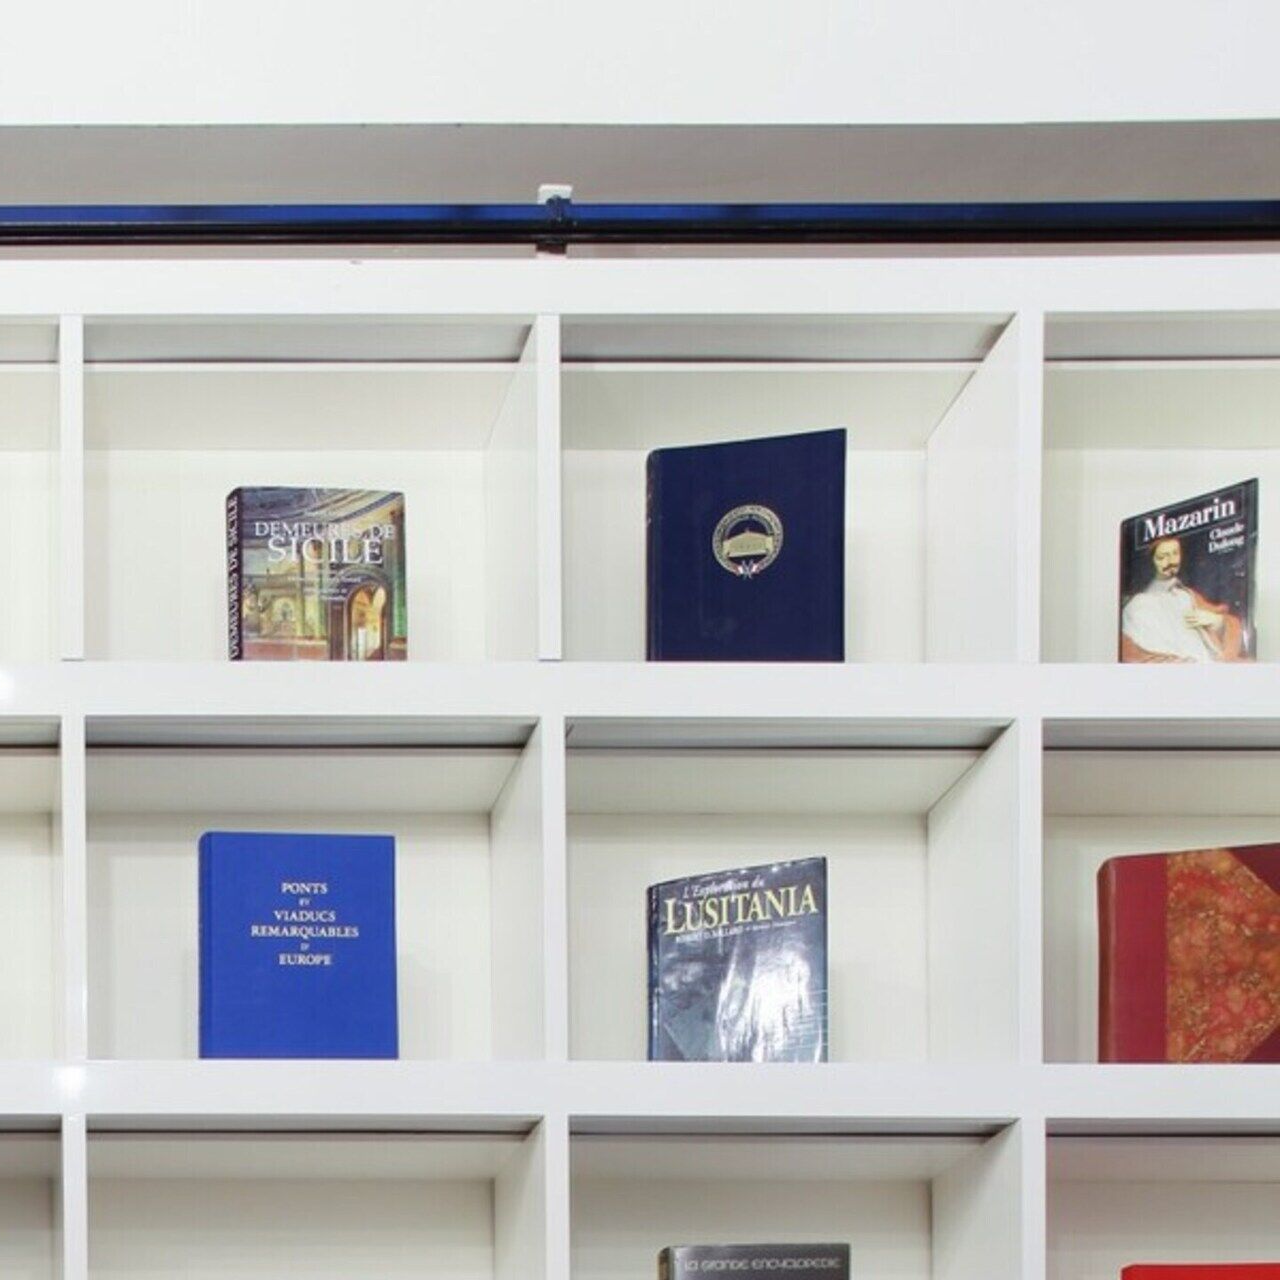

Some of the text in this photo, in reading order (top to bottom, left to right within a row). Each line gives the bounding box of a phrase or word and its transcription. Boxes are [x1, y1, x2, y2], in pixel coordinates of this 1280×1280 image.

[1143, 498, 1235, 542] Mazarin
[255, 521, 366, 539] DEMEUR
[268, 536, 383, 564] SICILE
[282, 882, 328, 894] PONTS
[273, 910, 336, 922] VIADUCS
[663, 884, 818, 936] LUSITANIA
[251, 925, 359, 939] REMARQUABLES
[278, 954, 332, 965] EUROPE
